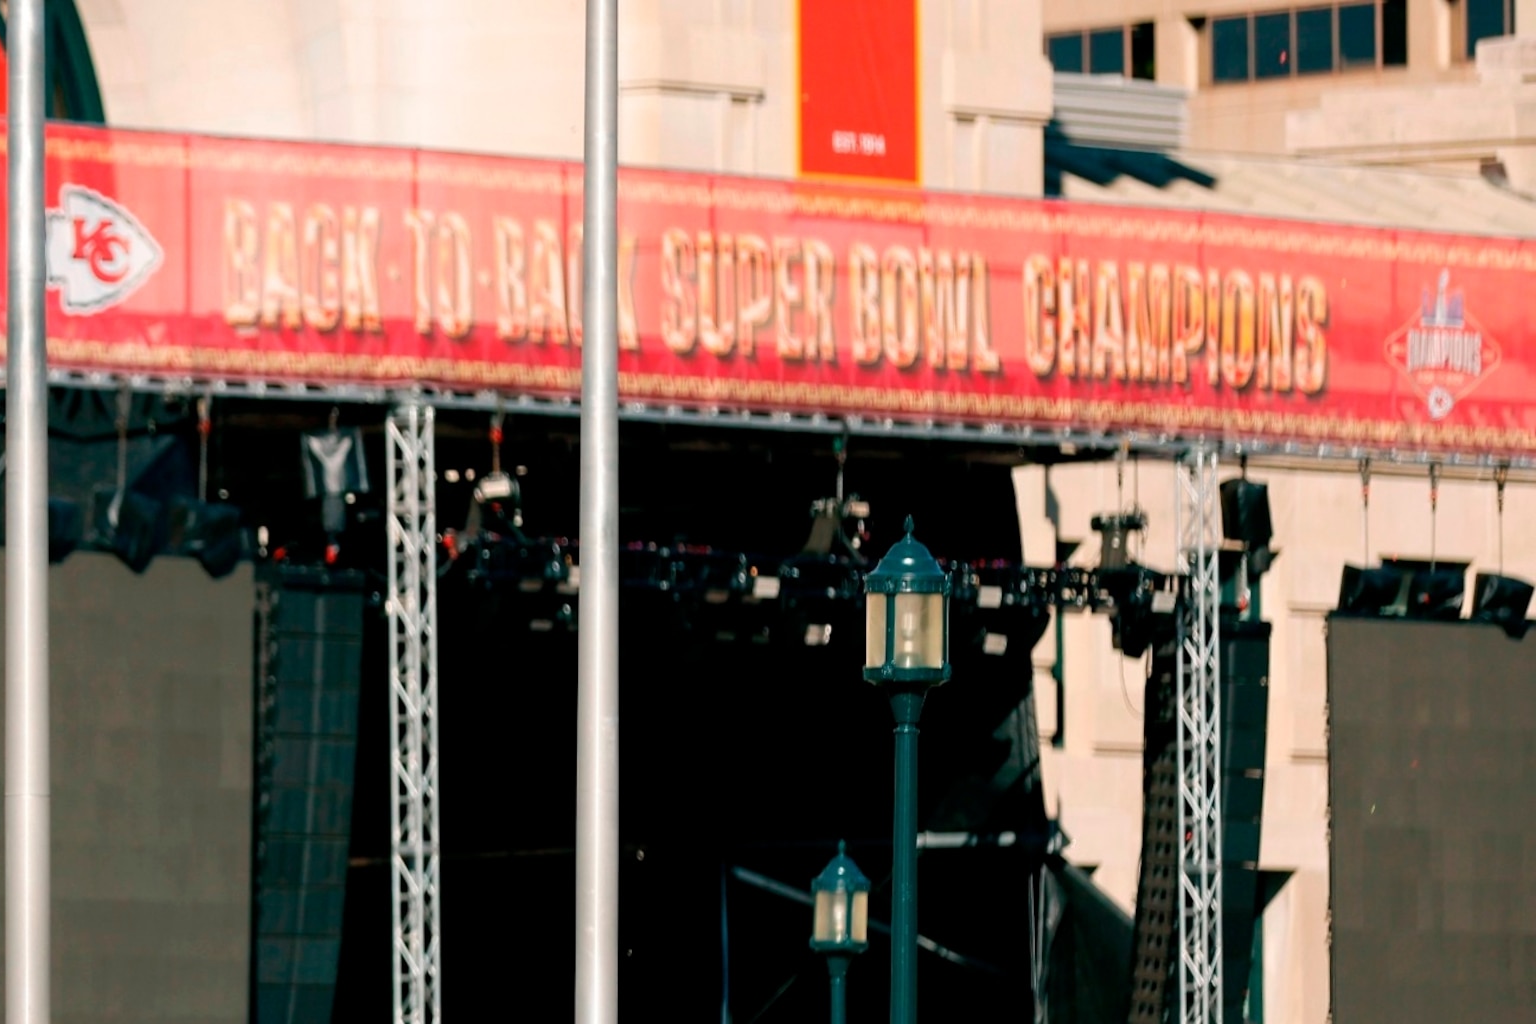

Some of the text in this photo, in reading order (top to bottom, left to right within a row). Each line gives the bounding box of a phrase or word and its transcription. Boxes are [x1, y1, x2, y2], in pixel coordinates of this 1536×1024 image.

[659, 227, 838, 364] SUPER
[847, 238, 1003, 375] BOWL
[1022, 252, 1331, 396] CHAMPIONS
